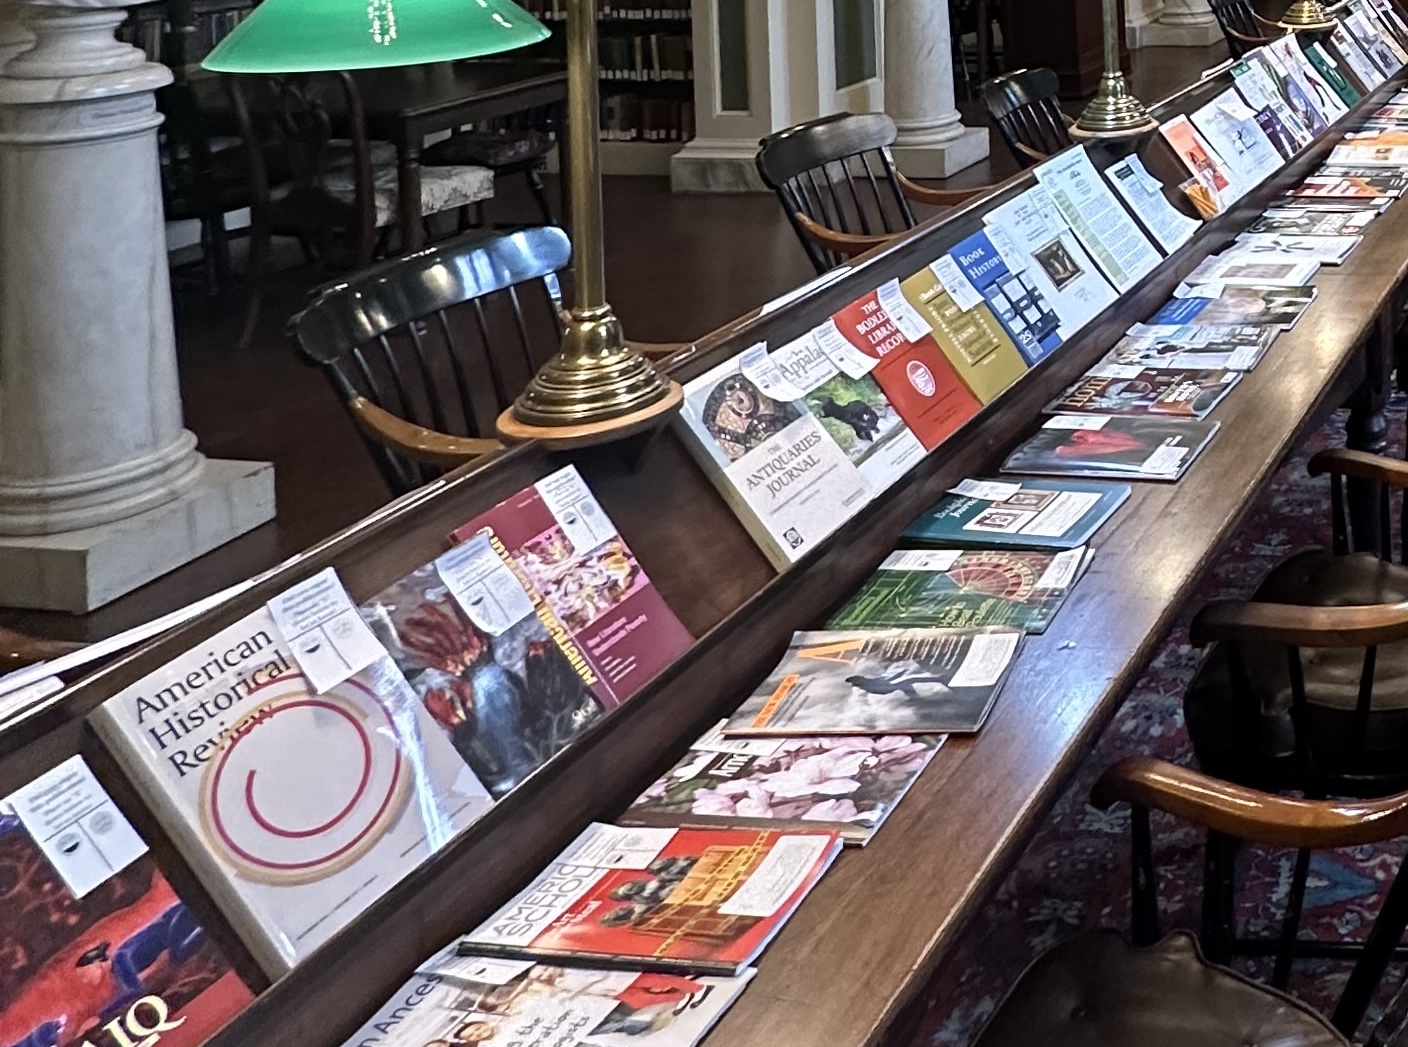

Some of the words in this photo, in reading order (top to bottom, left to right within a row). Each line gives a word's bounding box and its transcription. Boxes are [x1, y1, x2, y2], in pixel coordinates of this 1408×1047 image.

[869, 322, 897, 344] LIBRA
[876, 333, 905, 358] RECOR
[1061, 376, 1113, 408] hom
[746, 431, 822, 490] ANTIQUARIES
[765, 454, 821, 499] JOURNAL
[134, 629, 274, 725] American
[150, 649, 292, 750] Historical
[167, 703, 274, 778] Review
[492, 864, 579, 936] AMERIC
[506, 865, 598, 938] SCHOL
[80, 995, 188, 1047] IQ
[374, 974, 444, 1034] Ances
